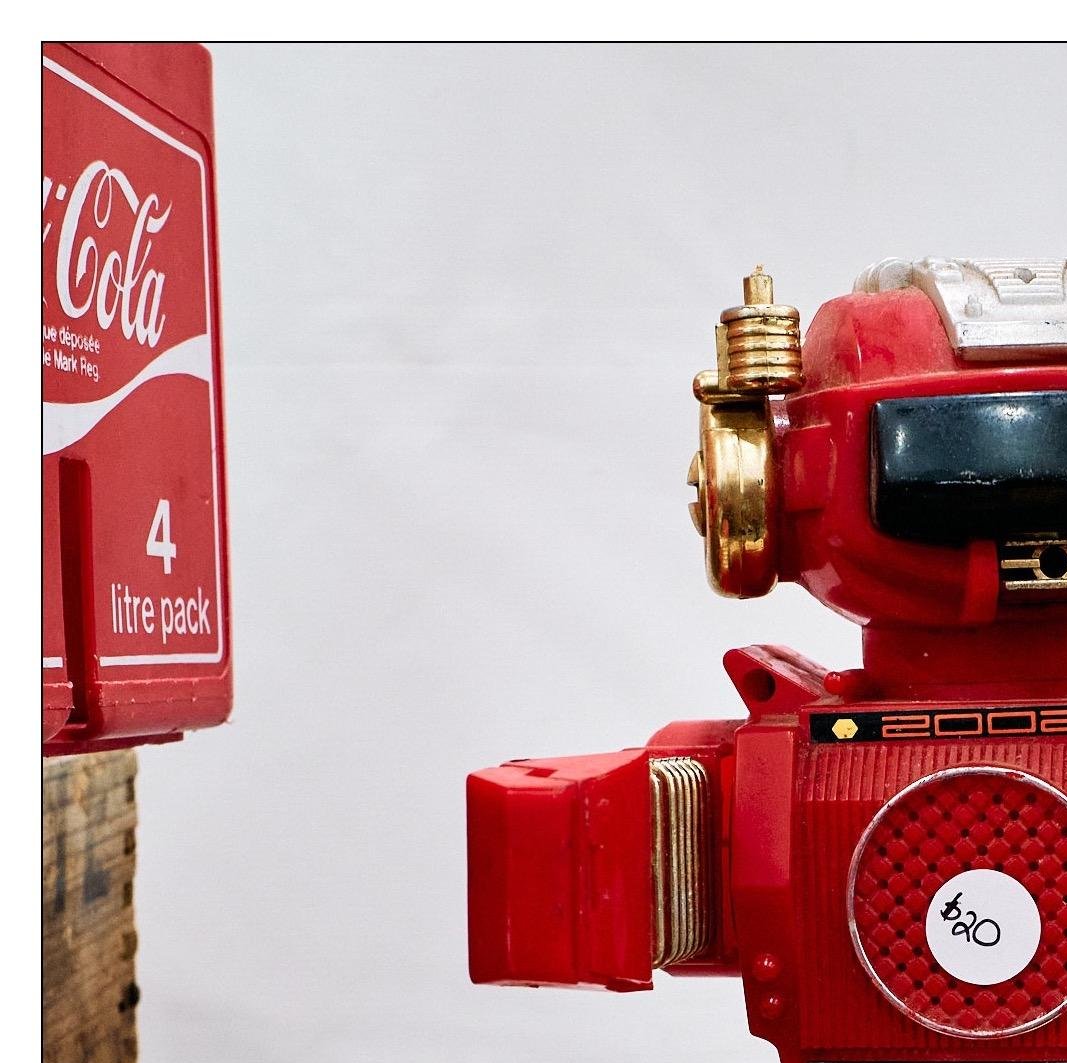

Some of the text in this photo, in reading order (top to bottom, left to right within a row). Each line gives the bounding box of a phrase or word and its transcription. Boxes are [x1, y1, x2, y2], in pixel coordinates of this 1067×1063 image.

[53, 348, 78, 373] Mark
[59, 325, 100, 354] déposée
[146, 499, 176, 575] 4
[111, 583, 211, 645] litre pack
[940, 892, 1001, 947] $20
